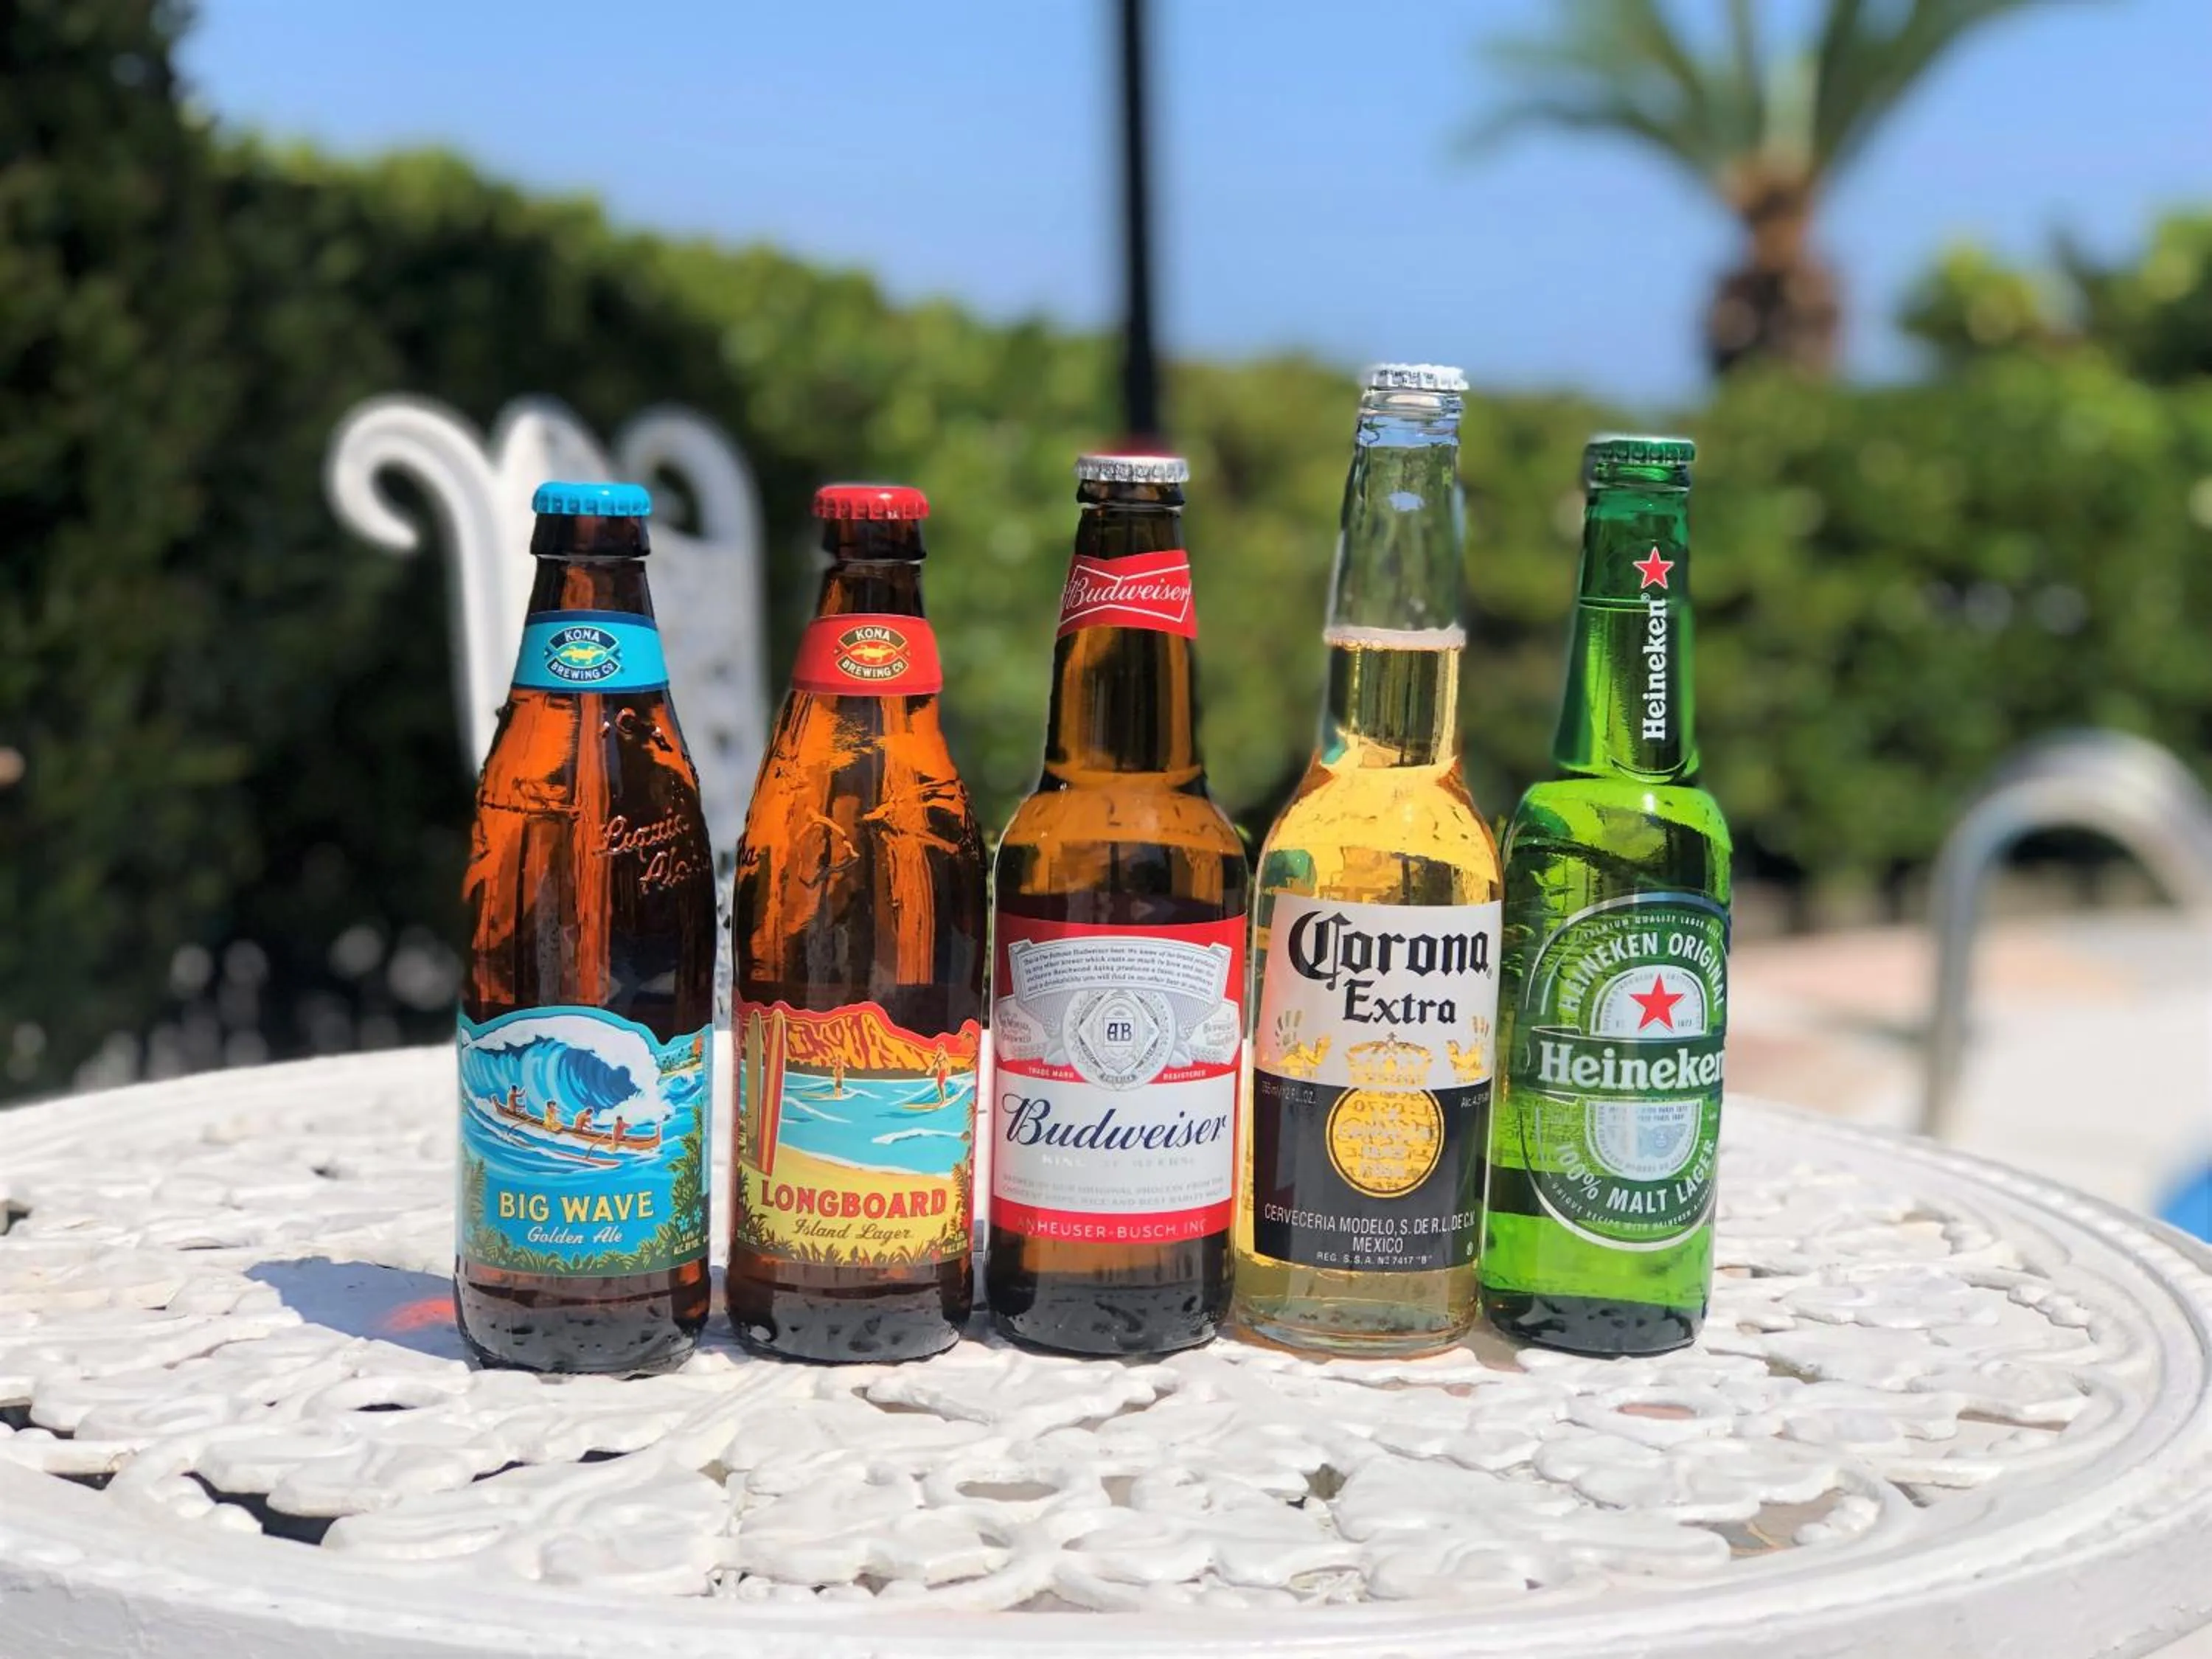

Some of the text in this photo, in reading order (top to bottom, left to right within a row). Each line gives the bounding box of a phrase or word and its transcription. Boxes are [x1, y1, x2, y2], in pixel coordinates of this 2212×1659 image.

[1062, 576, 1192, 610] Budweiser
[564, 629, 600, 642] KONA
[855, 627, 890, 641] KONA
[550, 661, 601, 679] BREWING
[841, 659, 891, 678] BREWING
[1642, 598, 1666, 741] Heineken
[1287, 910, 1489, 991] Corona
[1557, 931, 1658, 1012] HEINEKEN
[1668, 932, 1725, 1011] ORIGINAL
[1343, 978, 1457, 1025] Extra
[1002, 1093, 1228, 1150] Budweiser
[1557, 1142, 1602, 1200] 100%
[1606, 1186, 1667, 1214] MALT
[1675, 1139, 1715, 1204] LAGER
[498, 1191, 655, 1223] BIG WAVE
[761, 1179, 947, 1219] LONGBOARD
[527, 1225, 624, 1245] Golden Ale
[791, 1218, 912, 1244] Island Lager
[1265, 1203, 1335, 1231] CERVECERIA
[1414, 1217, 1429, 1235] DE
[1353, 1236, 1404, 1254] MEXICO
